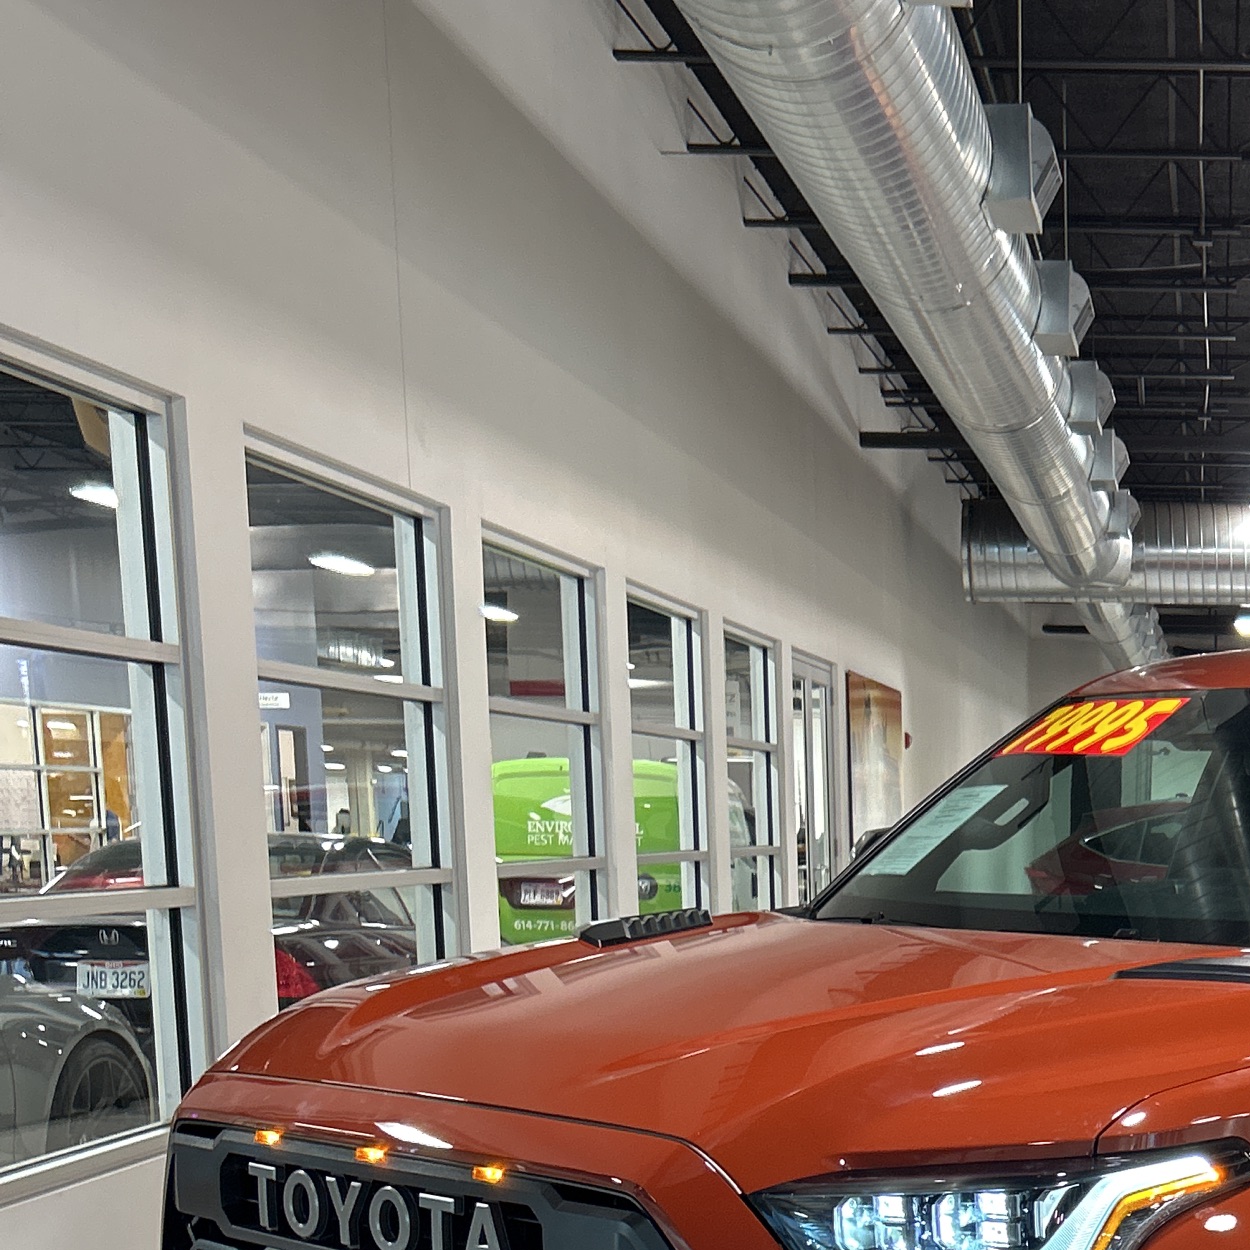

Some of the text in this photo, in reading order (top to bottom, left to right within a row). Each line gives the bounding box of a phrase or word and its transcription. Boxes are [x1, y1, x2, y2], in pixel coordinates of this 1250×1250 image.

[1003, 699, 1181, 753] 79995
[527, 834, 554, 845] PEST
[82, 970, 145, 989] JNB 3262
